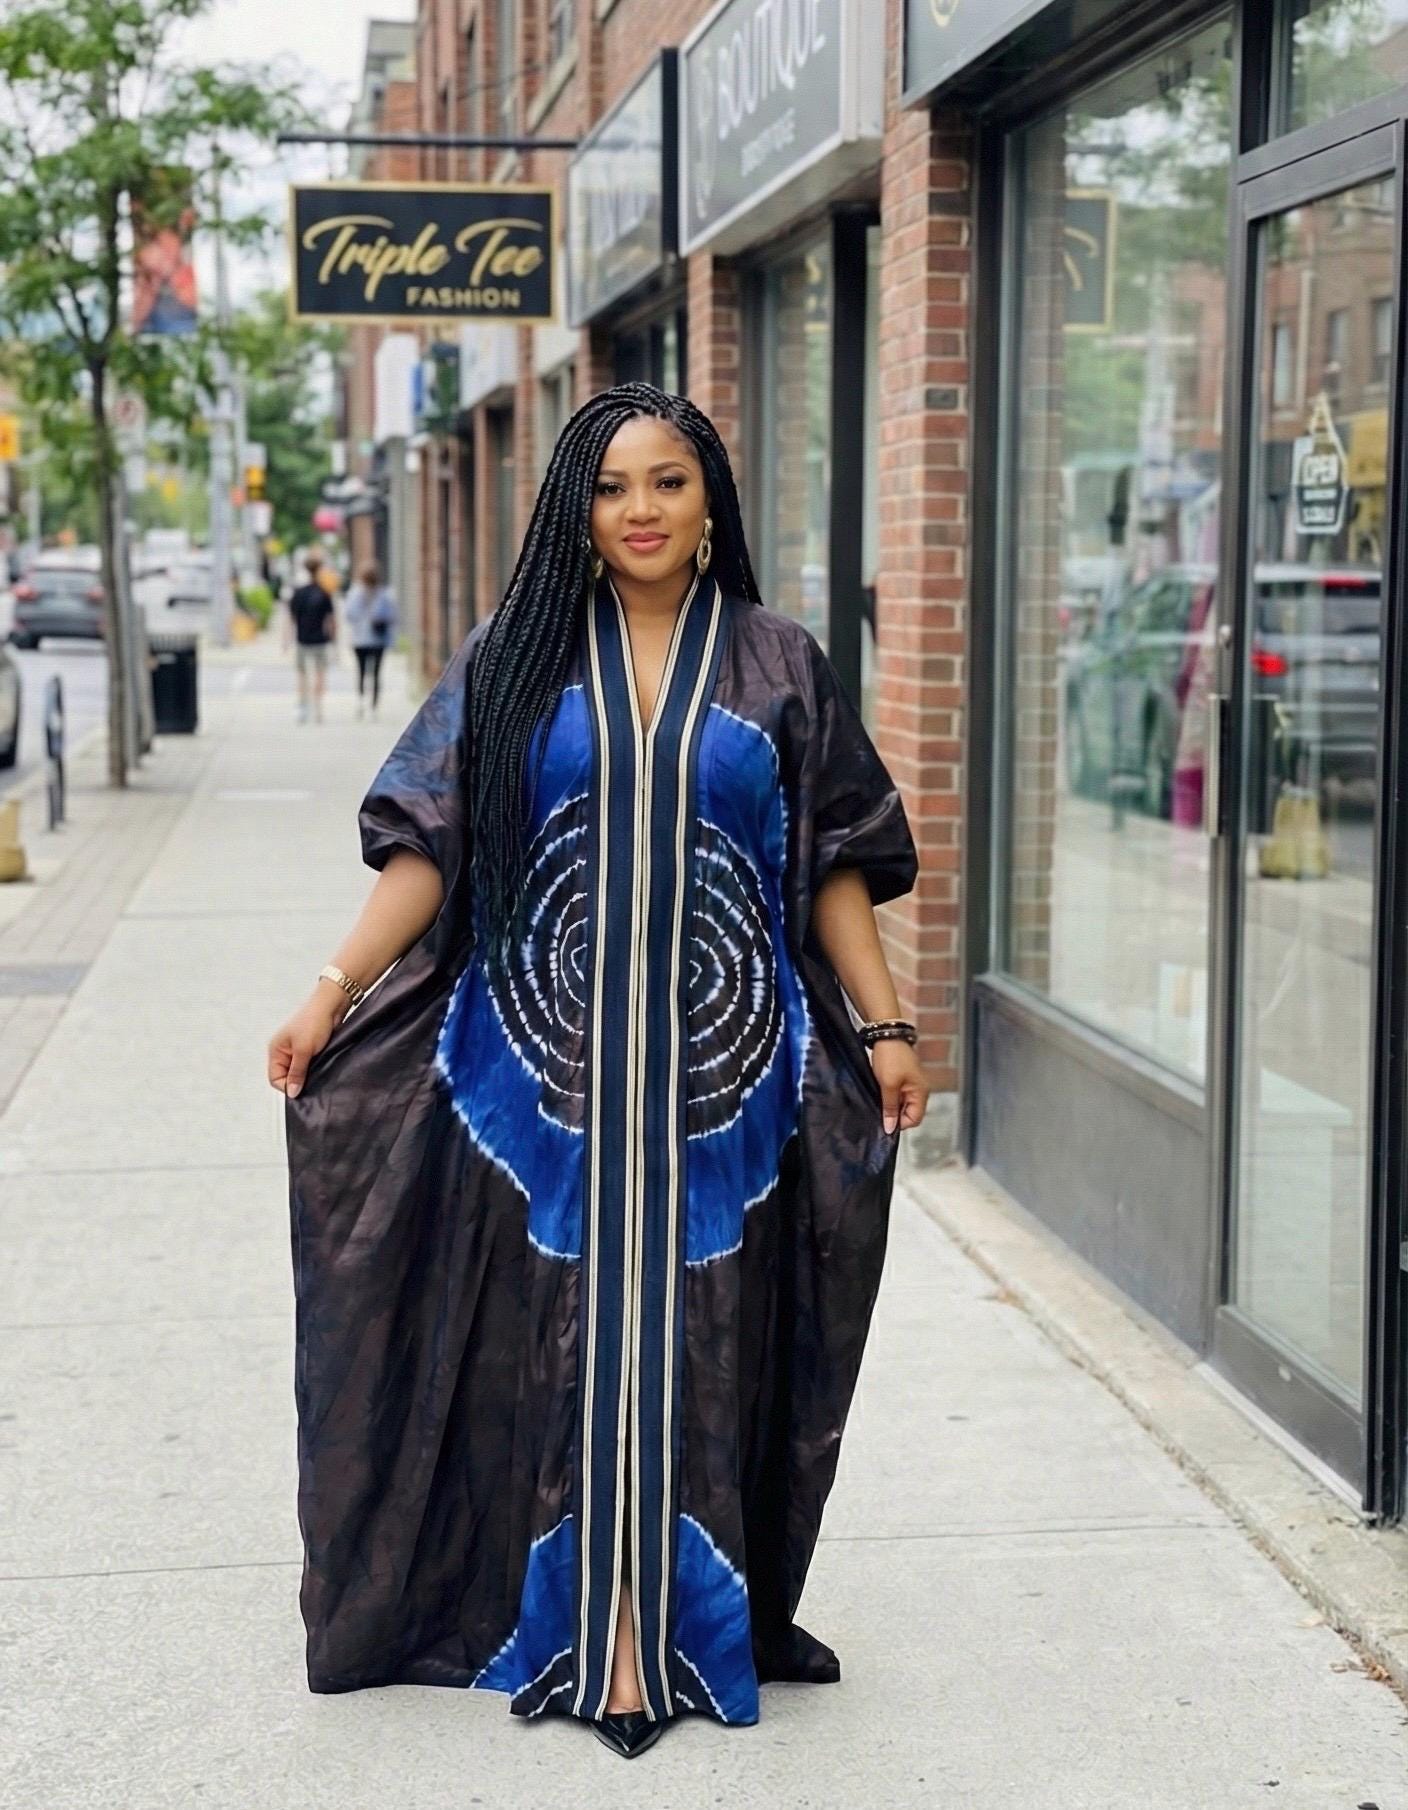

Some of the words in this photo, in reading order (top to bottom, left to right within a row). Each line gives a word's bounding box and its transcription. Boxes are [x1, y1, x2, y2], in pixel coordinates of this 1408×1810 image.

[302, 214, 449, 301] Triple
[455, 217, 543, 287] Tee
[406, 286, 521, 308] FASHION
